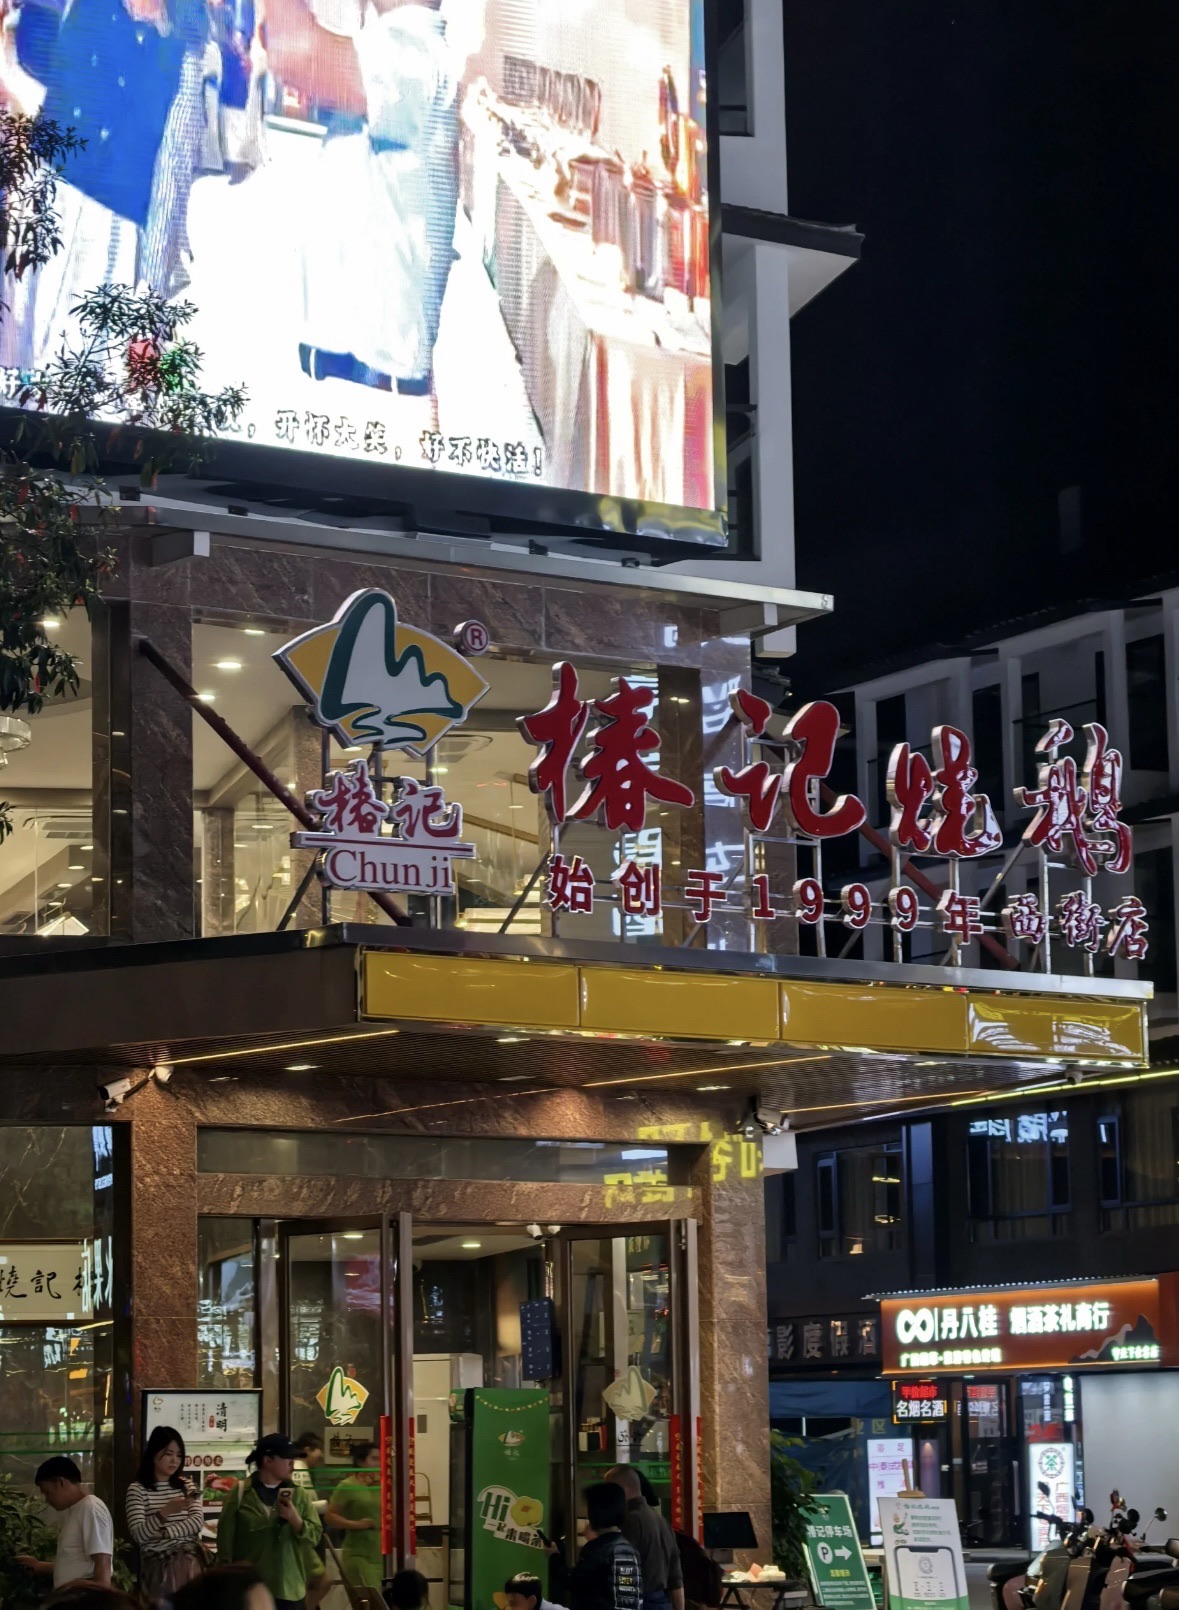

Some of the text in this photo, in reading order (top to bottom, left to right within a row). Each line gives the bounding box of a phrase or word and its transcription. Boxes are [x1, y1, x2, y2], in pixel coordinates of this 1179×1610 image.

[329, 850, 451, 889] Chunji
[897, 1400, 944, 1417] 名烟名酒
[482, 1492, 510, 1522] Hi
